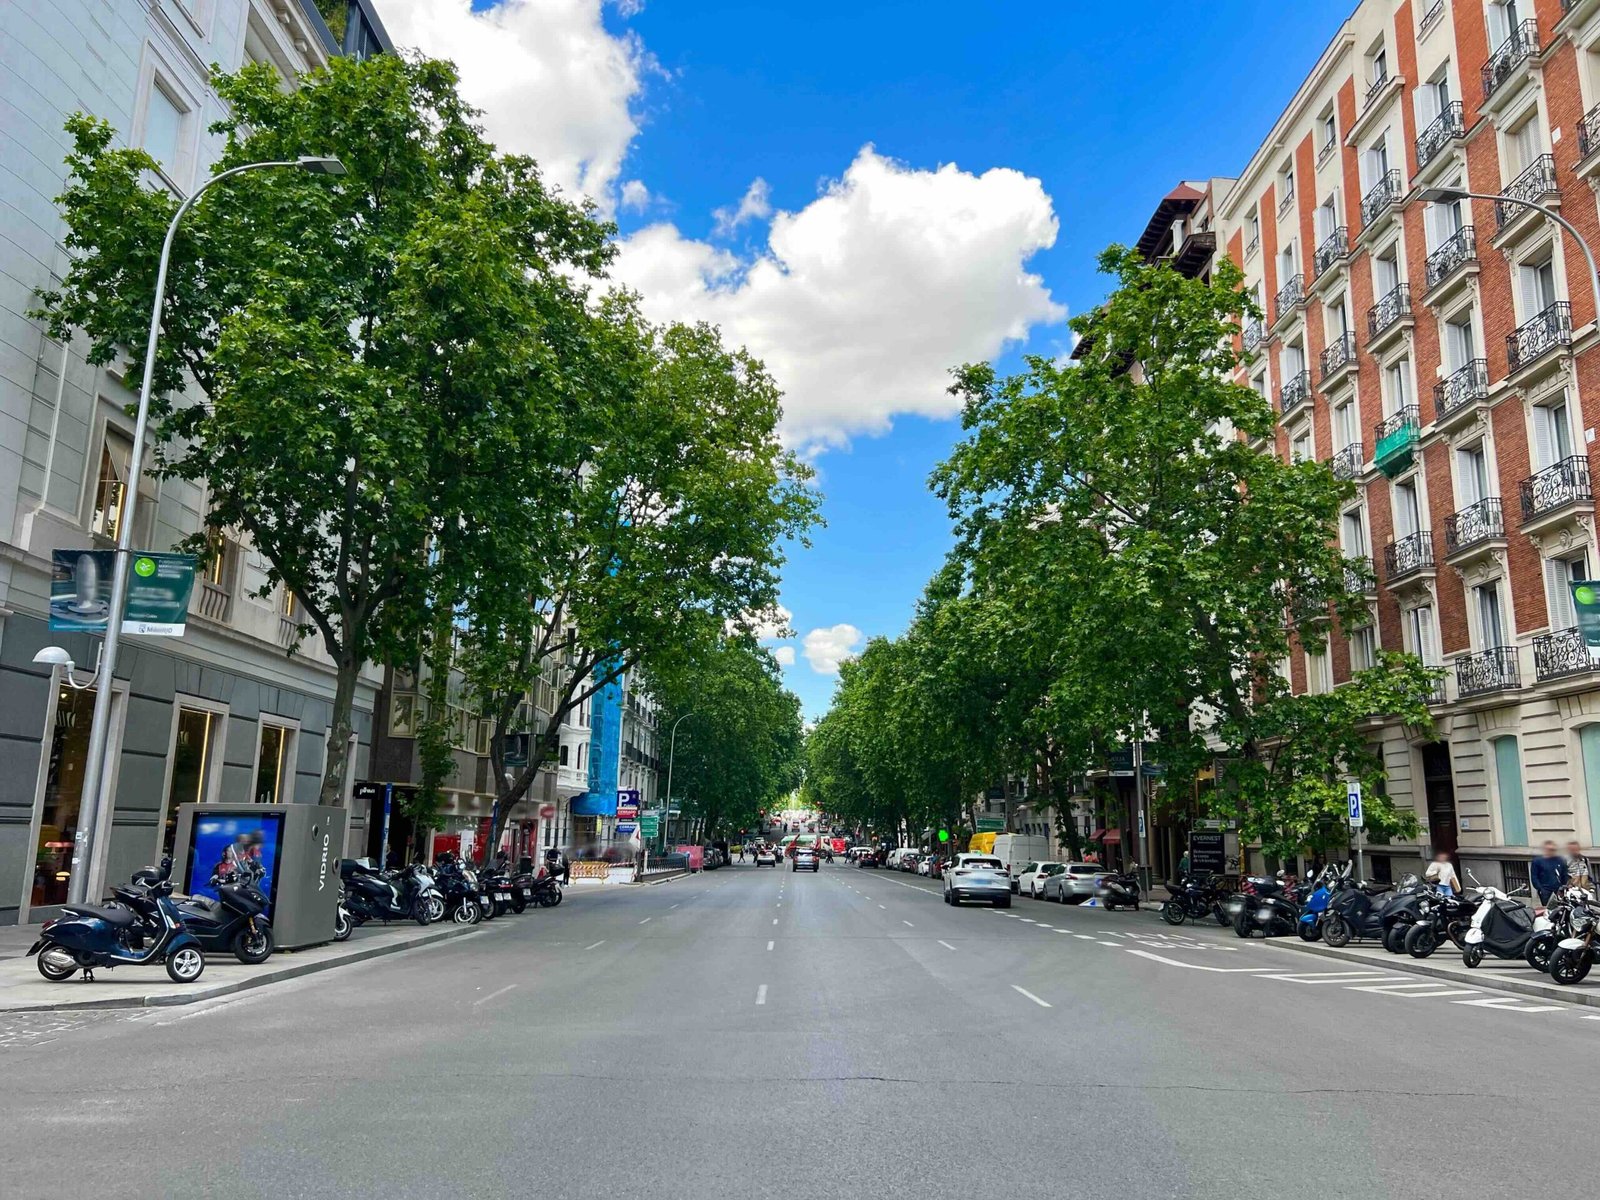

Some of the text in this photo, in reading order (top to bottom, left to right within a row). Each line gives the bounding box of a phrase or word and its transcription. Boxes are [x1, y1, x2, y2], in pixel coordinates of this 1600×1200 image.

[618, 793, 630, 807] P
[1350, 795, 1358, 816] P
[318, 834, 330, 892] VIDRIO
[1136, 940, 1238, 951] BUS
